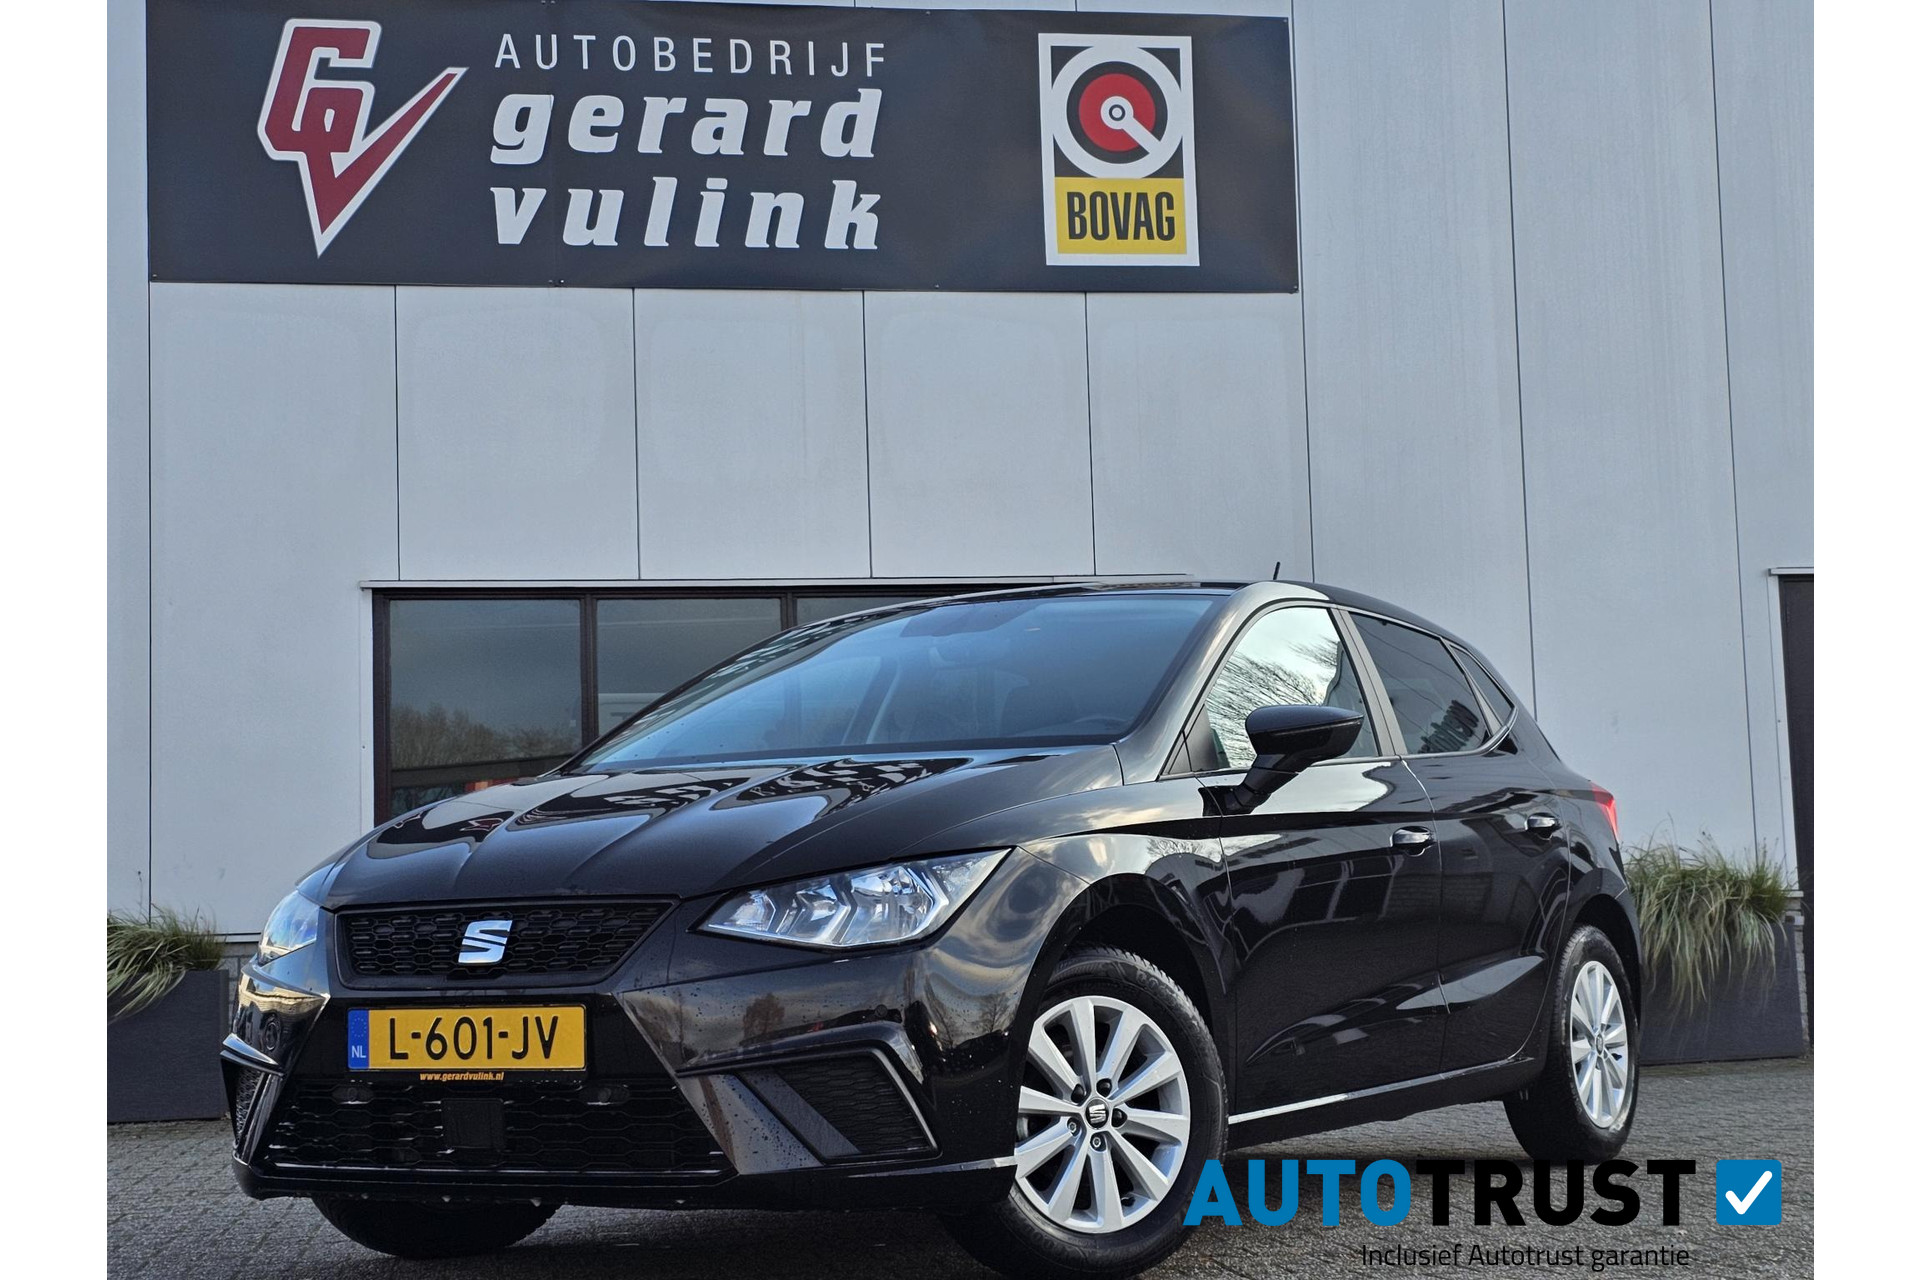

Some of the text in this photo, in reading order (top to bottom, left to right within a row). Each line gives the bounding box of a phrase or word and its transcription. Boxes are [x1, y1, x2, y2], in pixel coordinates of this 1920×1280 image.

[494, 33, 885, 77] AUTOBEDRIJF
[490, 87, 883, 165] gerard
[489, 176, 881, 250] vulink
[1066, 190, 1176, 241] BOVAG
[351, 1045, 367, 1059] NL
[389, 1015, 559, 1061] L-601-JV
[419, 1071, 505, 1083] www.gerardvulink.nl
